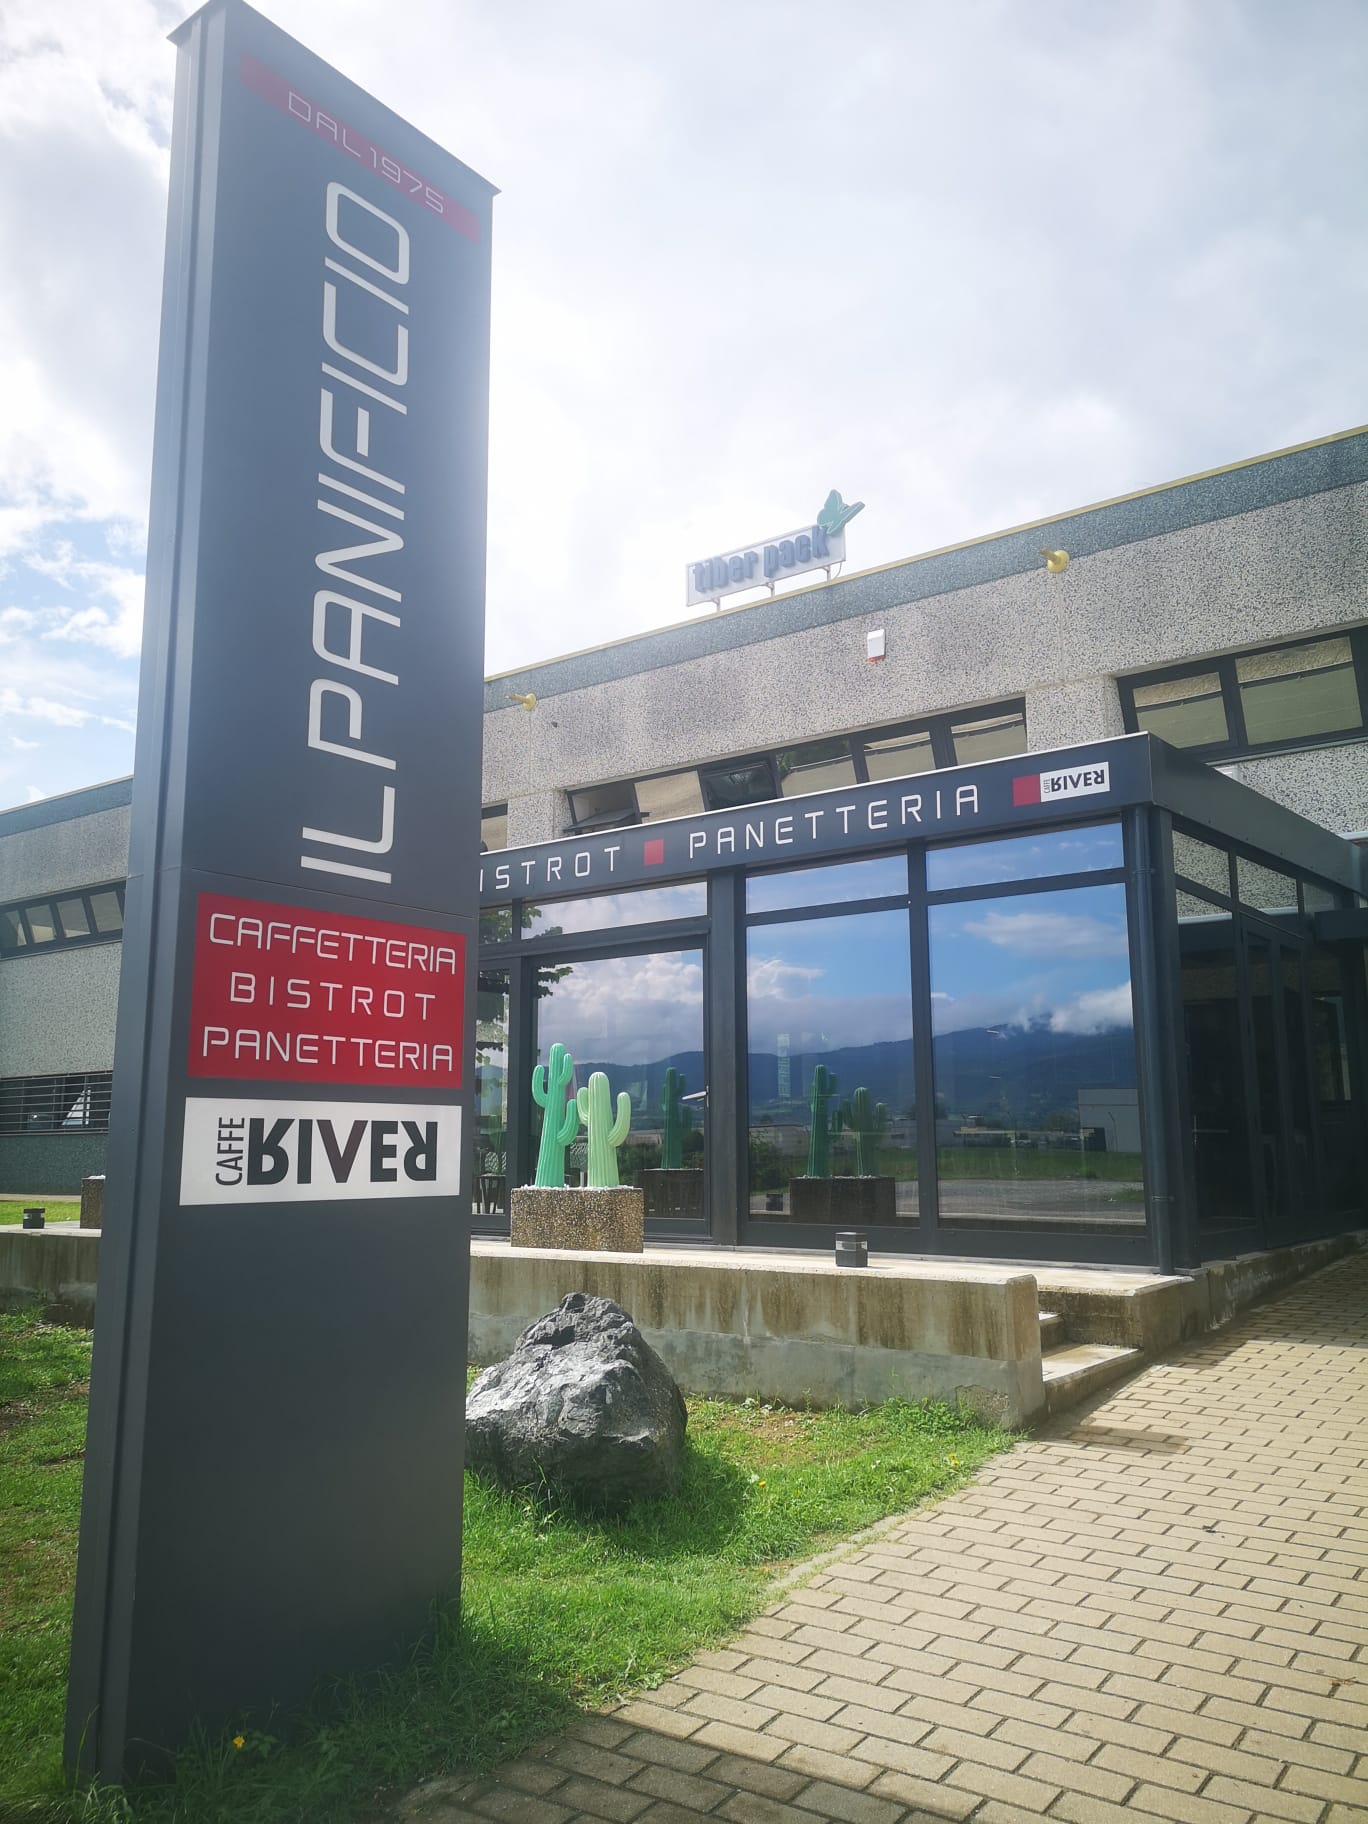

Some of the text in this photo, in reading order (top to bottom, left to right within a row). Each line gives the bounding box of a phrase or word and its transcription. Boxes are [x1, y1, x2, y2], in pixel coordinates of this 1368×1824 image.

[288, 91, 444, 215] DAL 1975
[693, 525, 830, 593] tiber pack
[1051, 769, 1105, 793] RIVER
[479, 784, 979, 892] ISTROT PANETTERIA
[209, 912, 456, 975] CAFFETTERIA
[230, 971, 436, 1021] BISTROT
[202, 1026, 453, 1072] PANETTERIA
[215, 1116, 245, 1186] CAFFE
[246, 1117, 439, 1186] RIVER
